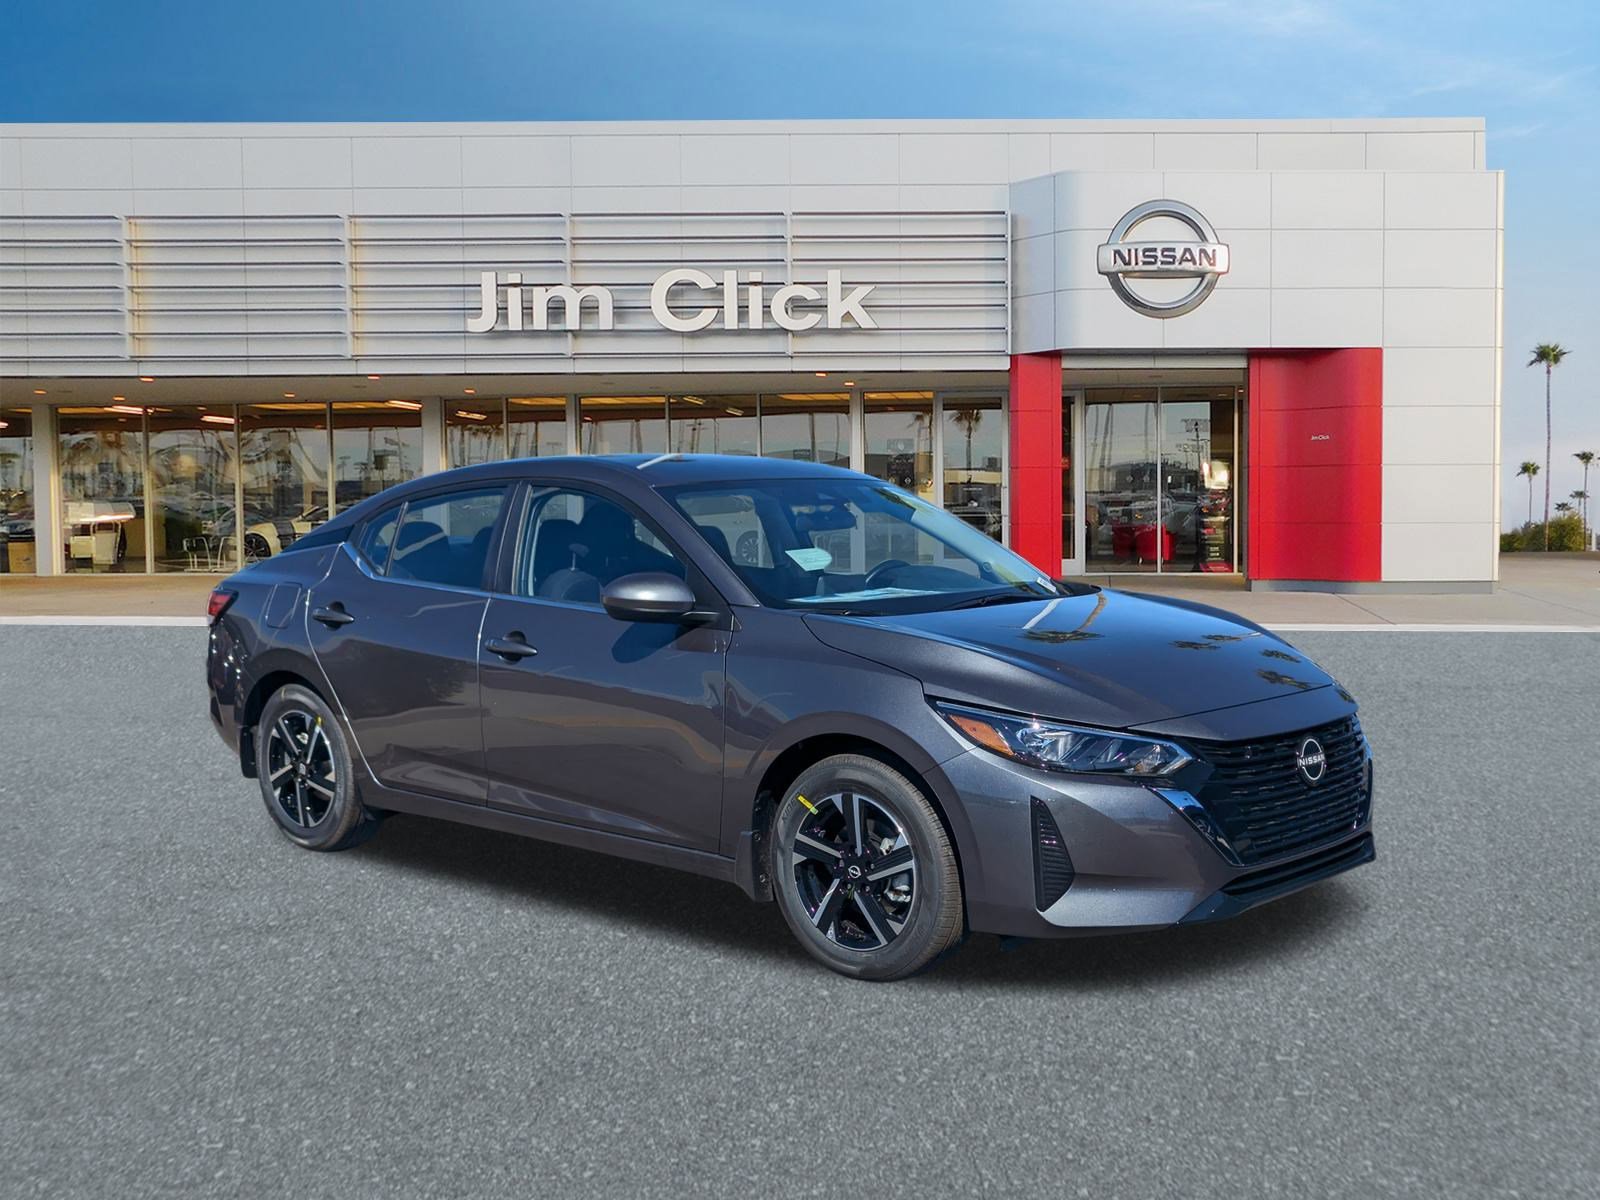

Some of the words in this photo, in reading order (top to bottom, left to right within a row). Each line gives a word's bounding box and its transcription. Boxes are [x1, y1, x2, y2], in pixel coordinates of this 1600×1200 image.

[1112, 247, 1217, 267] NISSAN
[467, 271, 614, 333] Jim
[650, 268, 879, 332] Click
[1299, 753, 1325, 767] NISSAN
